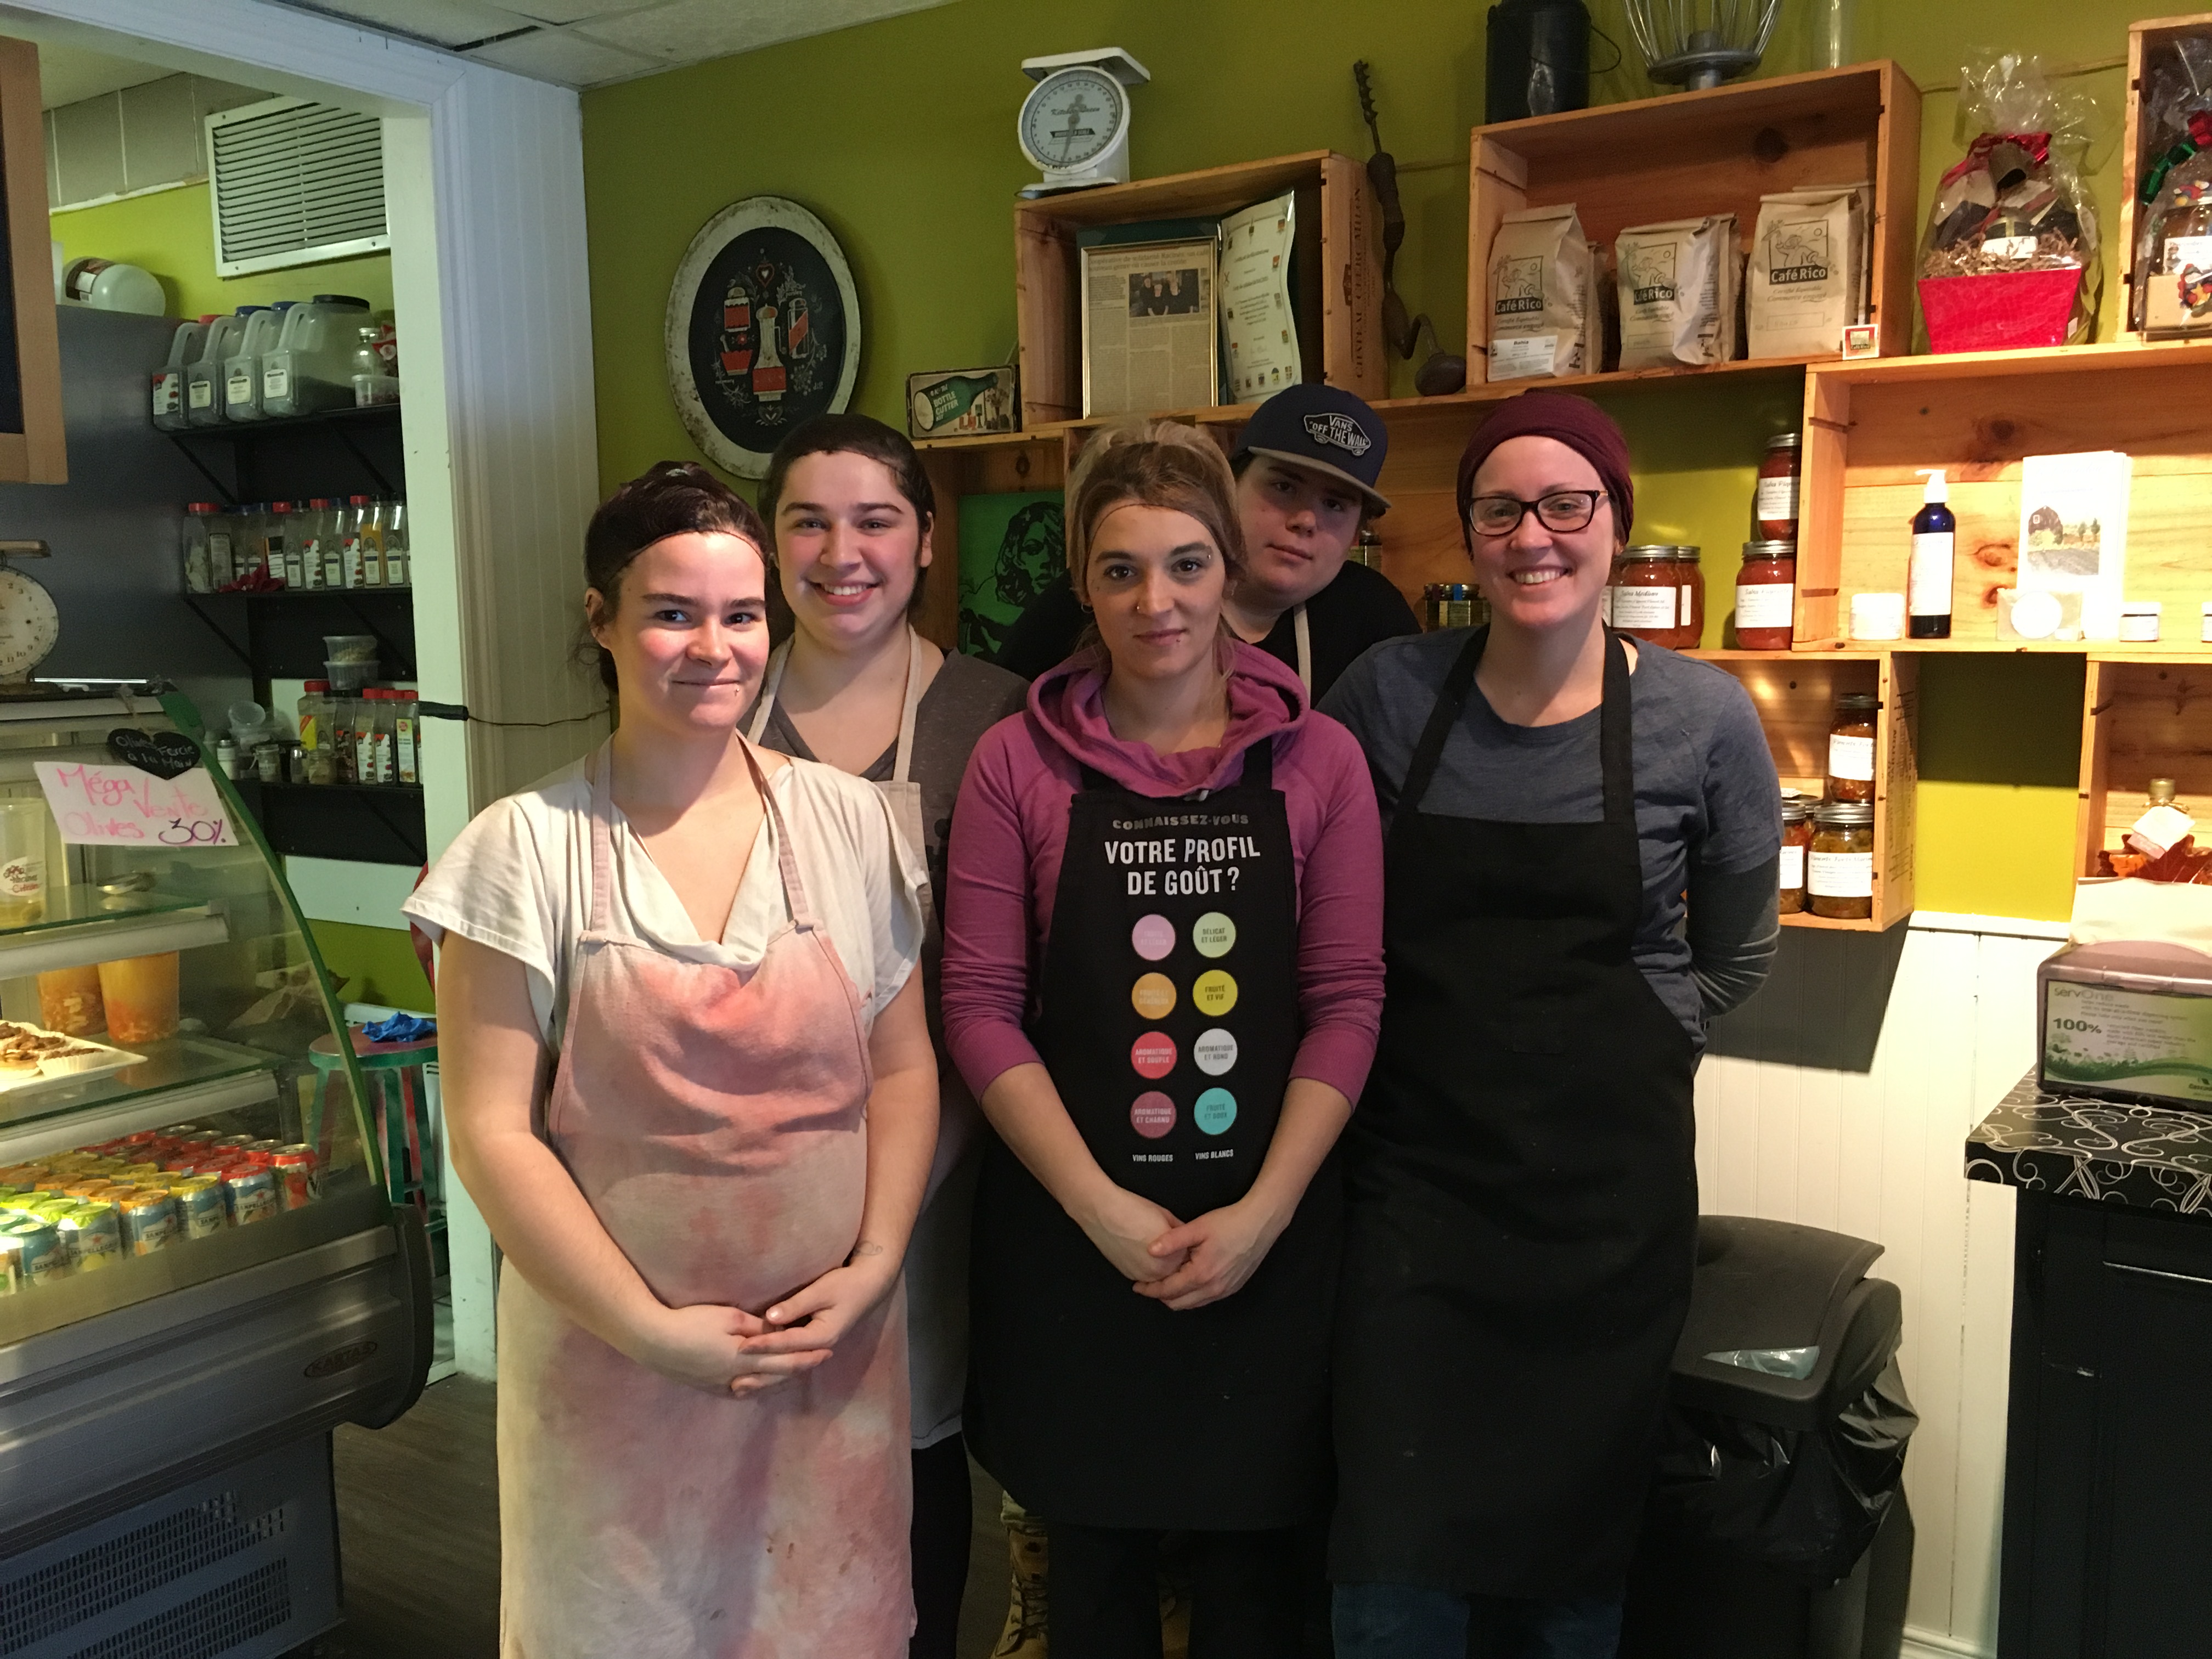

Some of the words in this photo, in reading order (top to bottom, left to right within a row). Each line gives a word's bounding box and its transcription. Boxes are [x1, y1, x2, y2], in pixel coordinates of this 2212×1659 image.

[1771, 269, 1798, 283] Café
[1799, 267, 1826, 280] Rico
[1648, 288, 1673, 299] Rico
[1496, 301, 1516, 313] Café
[1518, 299, 1542, 310] Rico
[933, 391, 956, 407] BOTTLE
[935, 399, 959, 415] CUTTER
[1329, 415, 1354, 432] VANS
[1330, 426, 1347, 444] THE
[57, 763, 136, 806] Méga
[133, 777, 208, 819] Vente
[64, 811, 145, 839] Olives
[158, 817, 227, 845] 30%
[1113, 814, 1249, 831] CONNAISSEZ-VOUS
[1104, 838, 1176, 865] VOTRE
[1184, 836, 1261, 863] PROFIL
[1127, 871, 1156, 895] DE
[1164, 865, 1222, 896] GOÛT
[1227, 866, 1240, 891] ?
[1203, 927, 1226, 935] DÉLICAT
[1209, 935, 1227, 943] LÉGER
[1205, 984, 1226, 993] FRUITÉ
[2054, 988, 2114, 1002] servOne
[2053, 1018, 2102, 1034] 100%
[1135, 1047, 1173, 1056] AROMATIQUE
[1198, 1045, 1234, 1053] AROMATIQUE
[1134, 1107, 1172, 1115] AROMATIQUE
[1148, 1154, 1173, 1163] ROUGES
[1195, 1152, 1210, 1160] VINS
[1210, 1149, 1234, 1159] BLANCS
